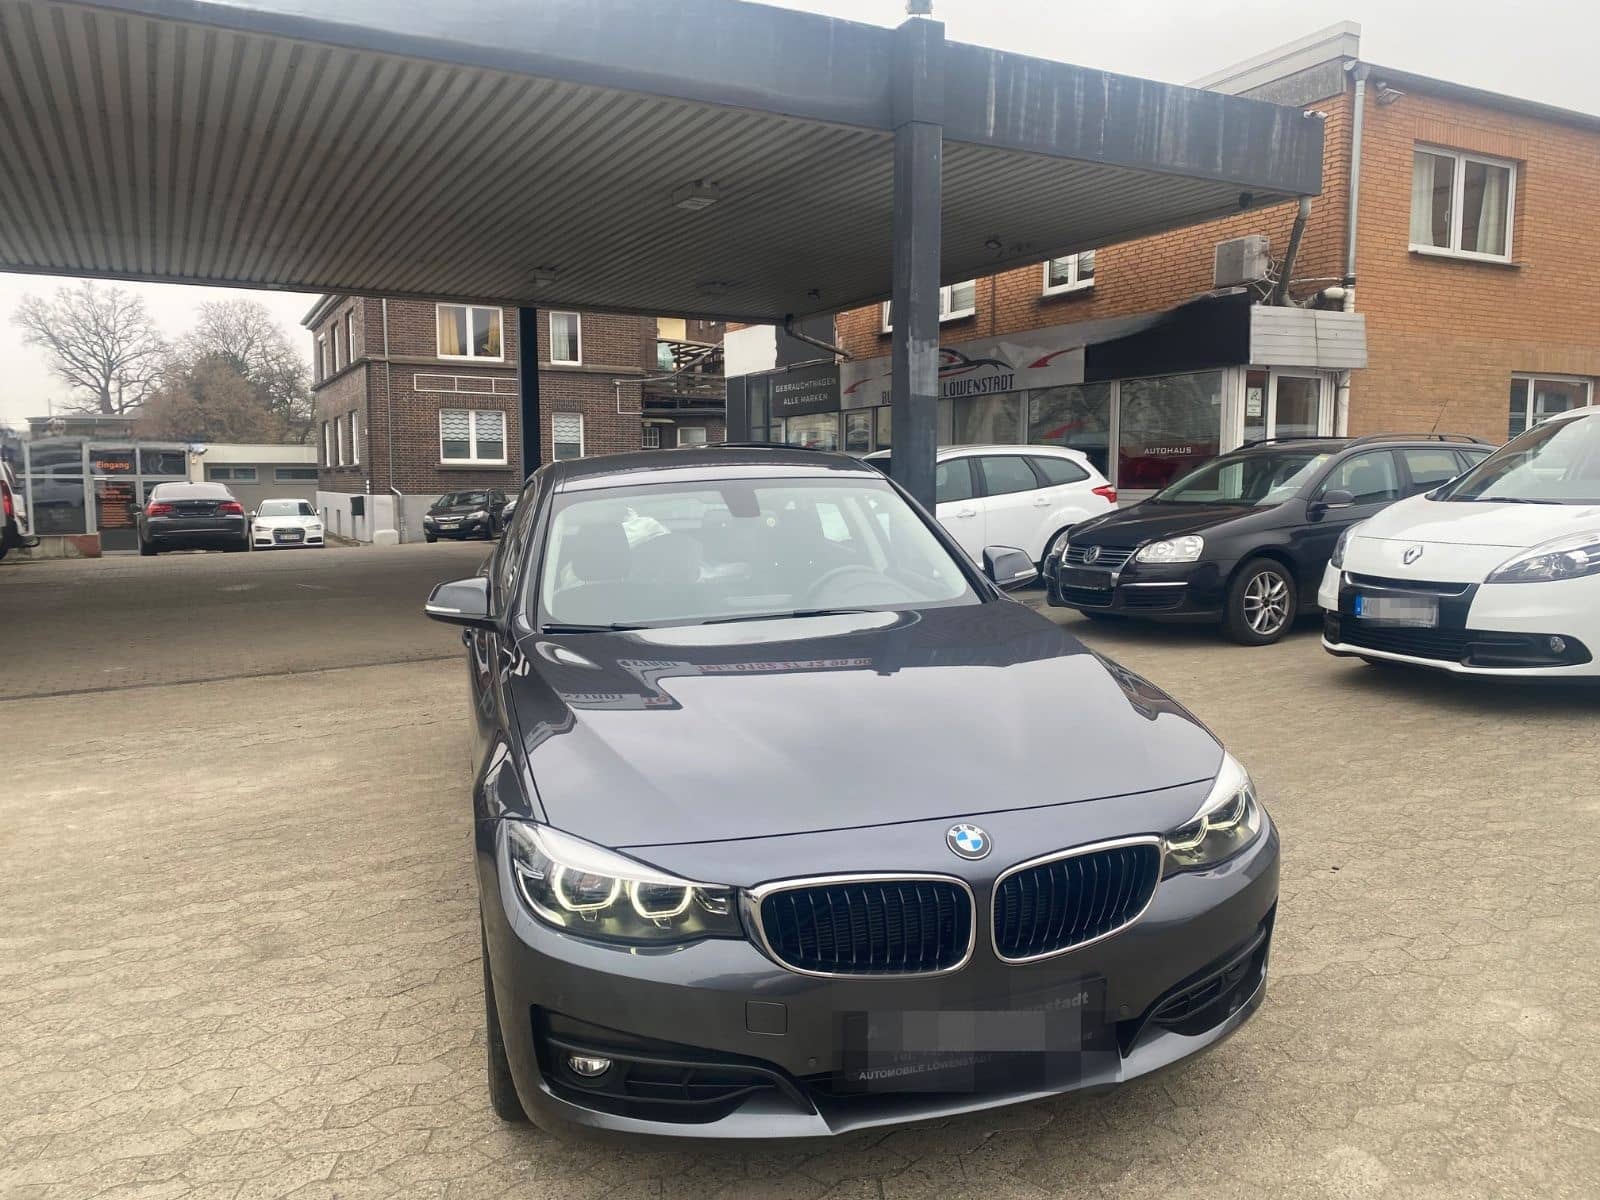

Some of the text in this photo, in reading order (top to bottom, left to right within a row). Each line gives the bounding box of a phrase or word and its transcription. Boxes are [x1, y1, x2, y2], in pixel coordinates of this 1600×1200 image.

[775, 377, 837, 393] GEBRAUCHTWAGEN
[942, 374, 1015, 398] LÖWENSTADT
[783, 392, 829, 406] ALLE MARKEN
[1143, 446, 1193, 455] AUTOHAUS
[95, 460, 130, 471] Eingang
[859, 1063, 926, 1081] AUTOMOBILE
